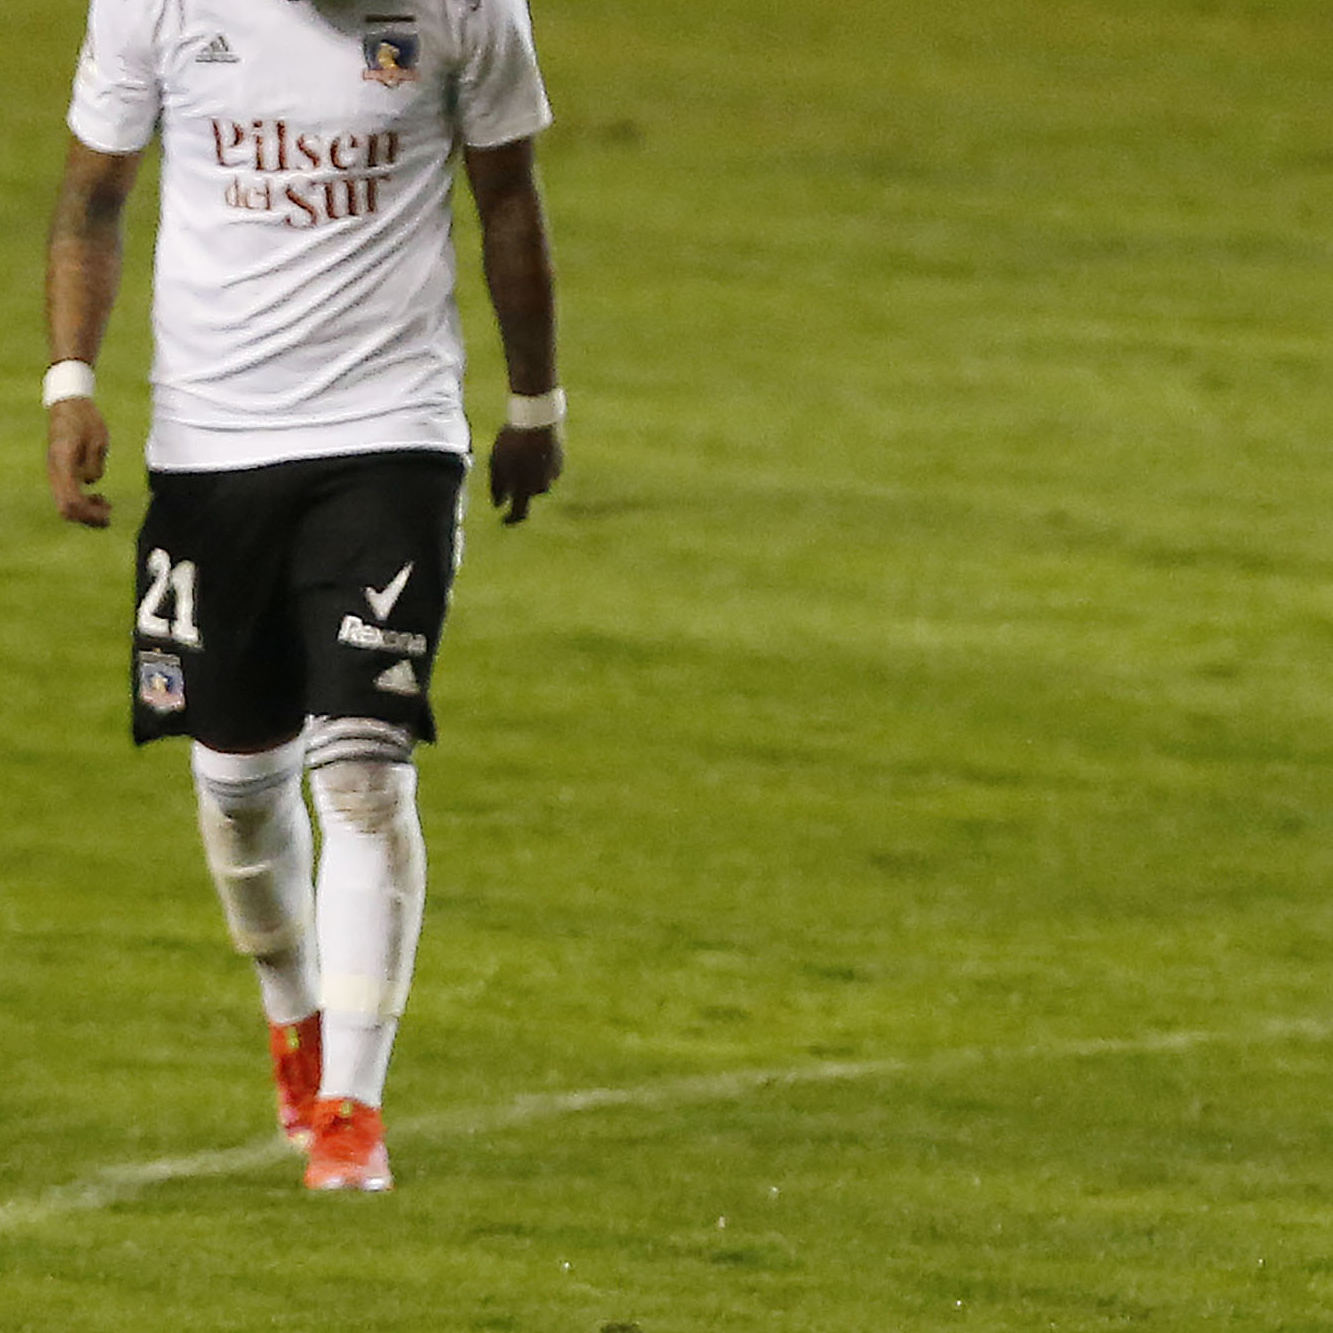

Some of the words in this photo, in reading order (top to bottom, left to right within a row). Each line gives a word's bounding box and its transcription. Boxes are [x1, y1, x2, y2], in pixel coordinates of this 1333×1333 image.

[210, 118, 400, 171] Pilsen
[225, 174, 272, 211] del
[284, 173, 391, 229] Sur
[137, 547, 200, 643] 21
